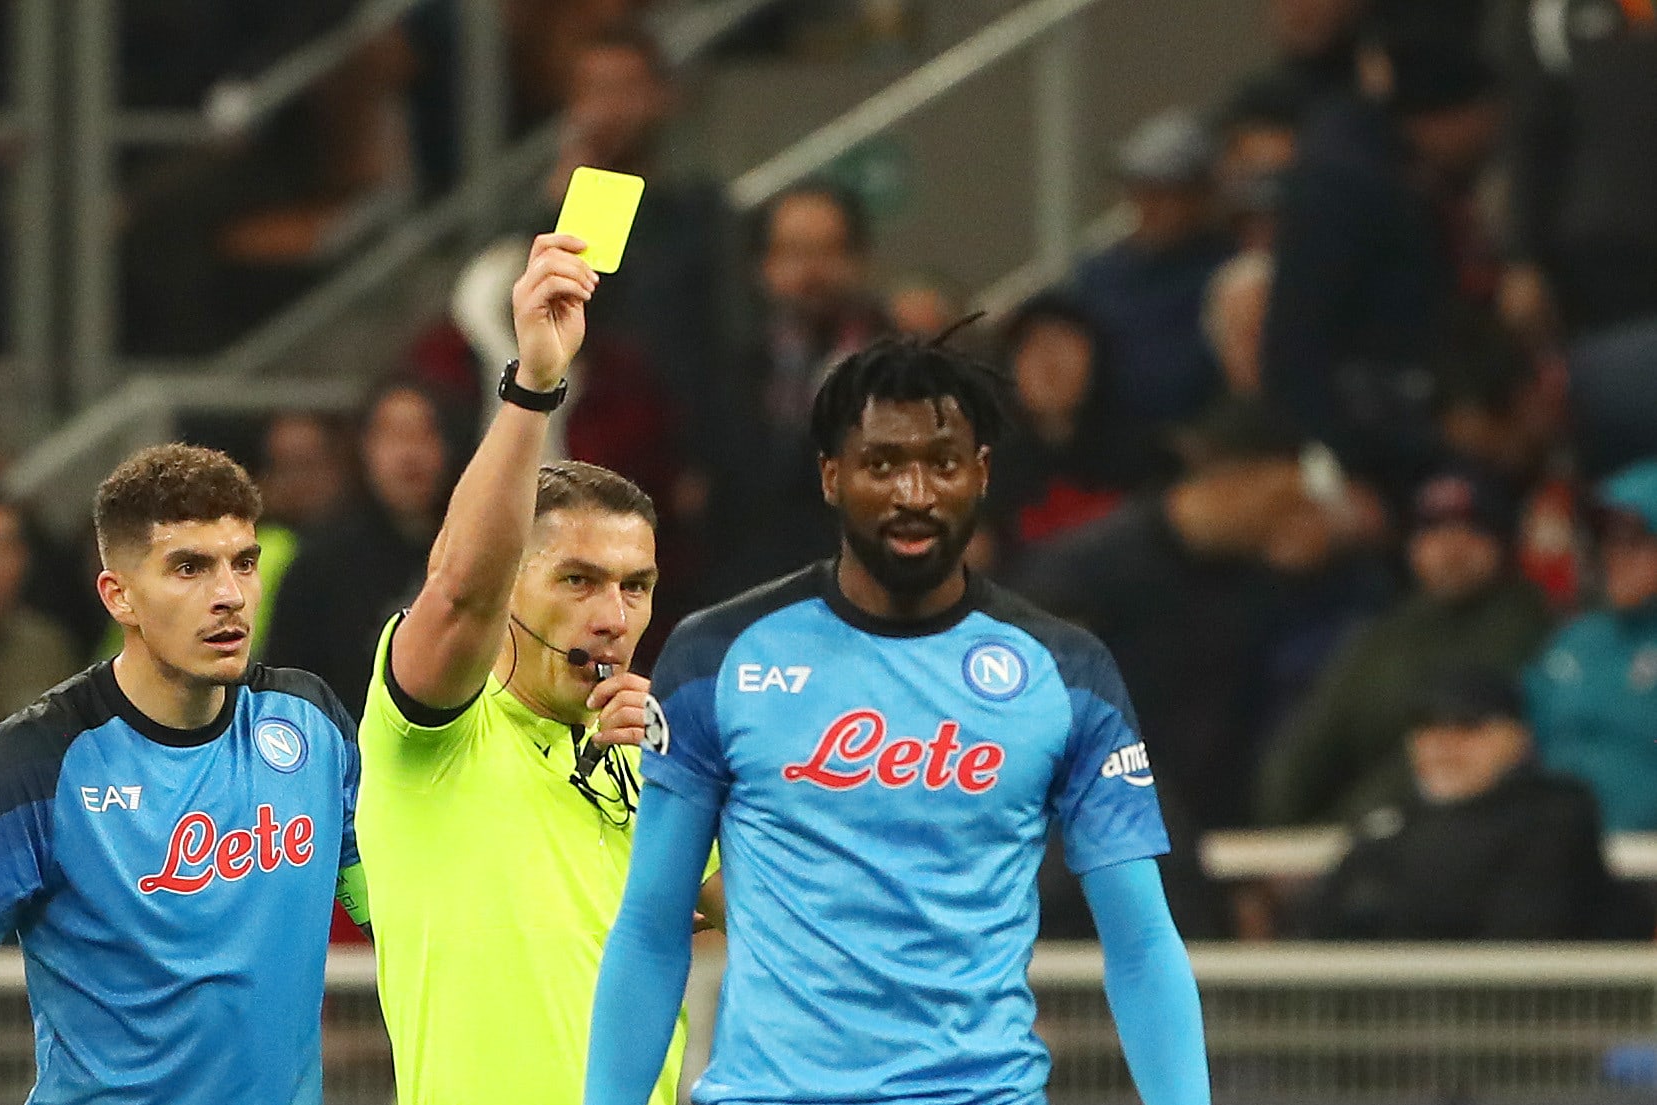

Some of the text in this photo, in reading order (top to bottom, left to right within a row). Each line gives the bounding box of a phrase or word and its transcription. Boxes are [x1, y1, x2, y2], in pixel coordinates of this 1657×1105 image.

[737, 664, 813, 693] EA7
[781, 707, 1005, 795] Lete
[81, 786, 142, 812] EA7
[138, 803, 314, 894] Lete
